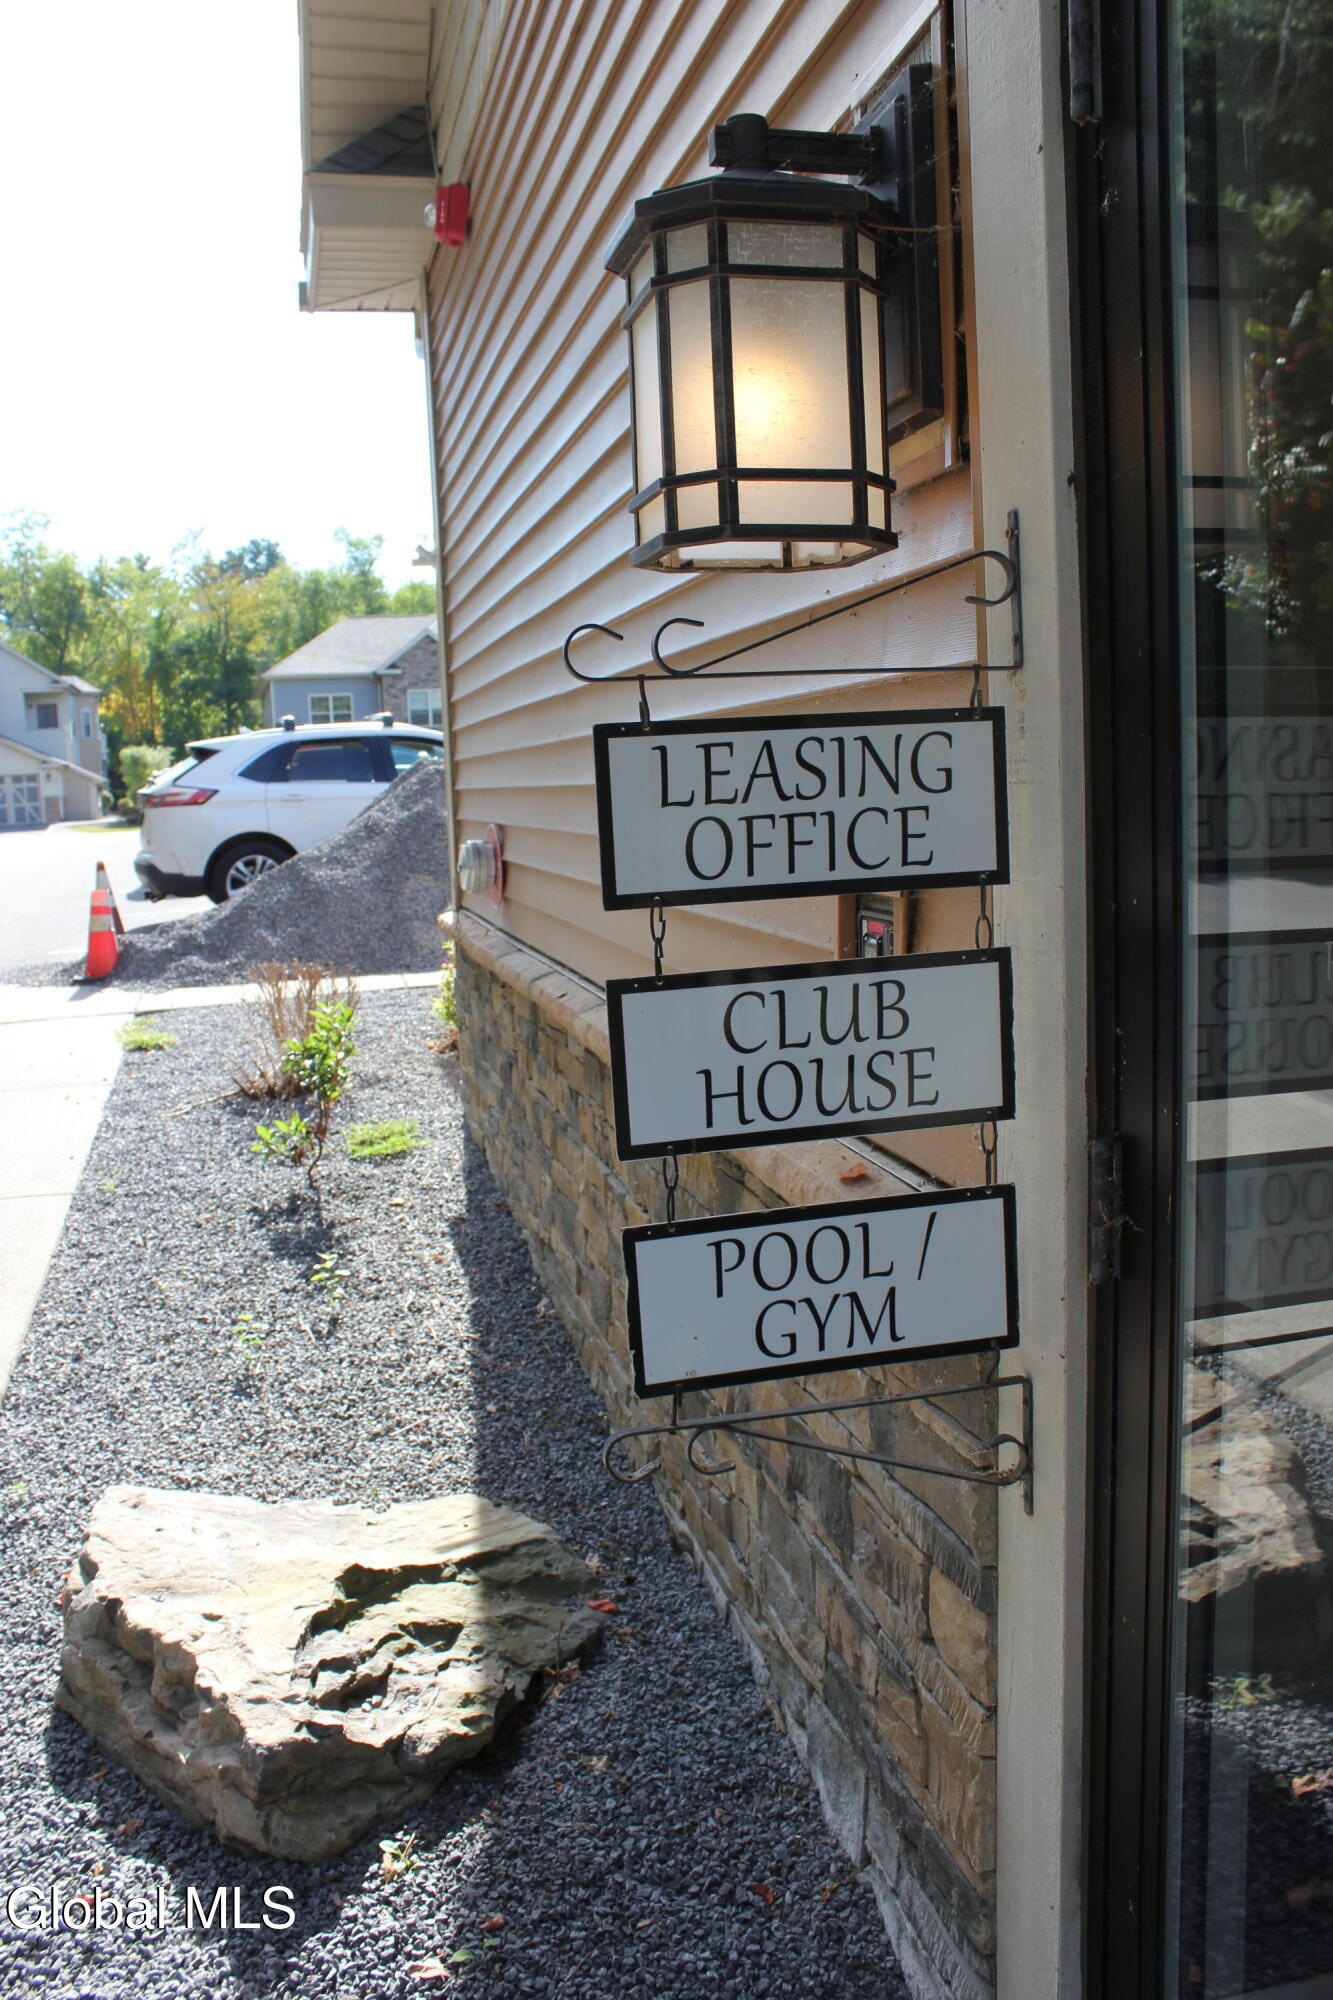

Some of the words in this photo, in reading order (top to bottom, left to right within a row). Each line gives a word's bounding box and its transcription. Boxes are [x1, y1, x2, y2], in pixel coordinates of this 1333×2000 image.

[651, 730, 953, 809] LEASING
[685, 805, 934, 881] OFFICE
[723, 979, 910, 1055] CLUB
[695, 1046, 939, 1129] HOUSE
[706, 1221, 894, 1299] POOL
[917, 1211, 938, 1281] /
[754, 1285, 906, 1359] GYM
